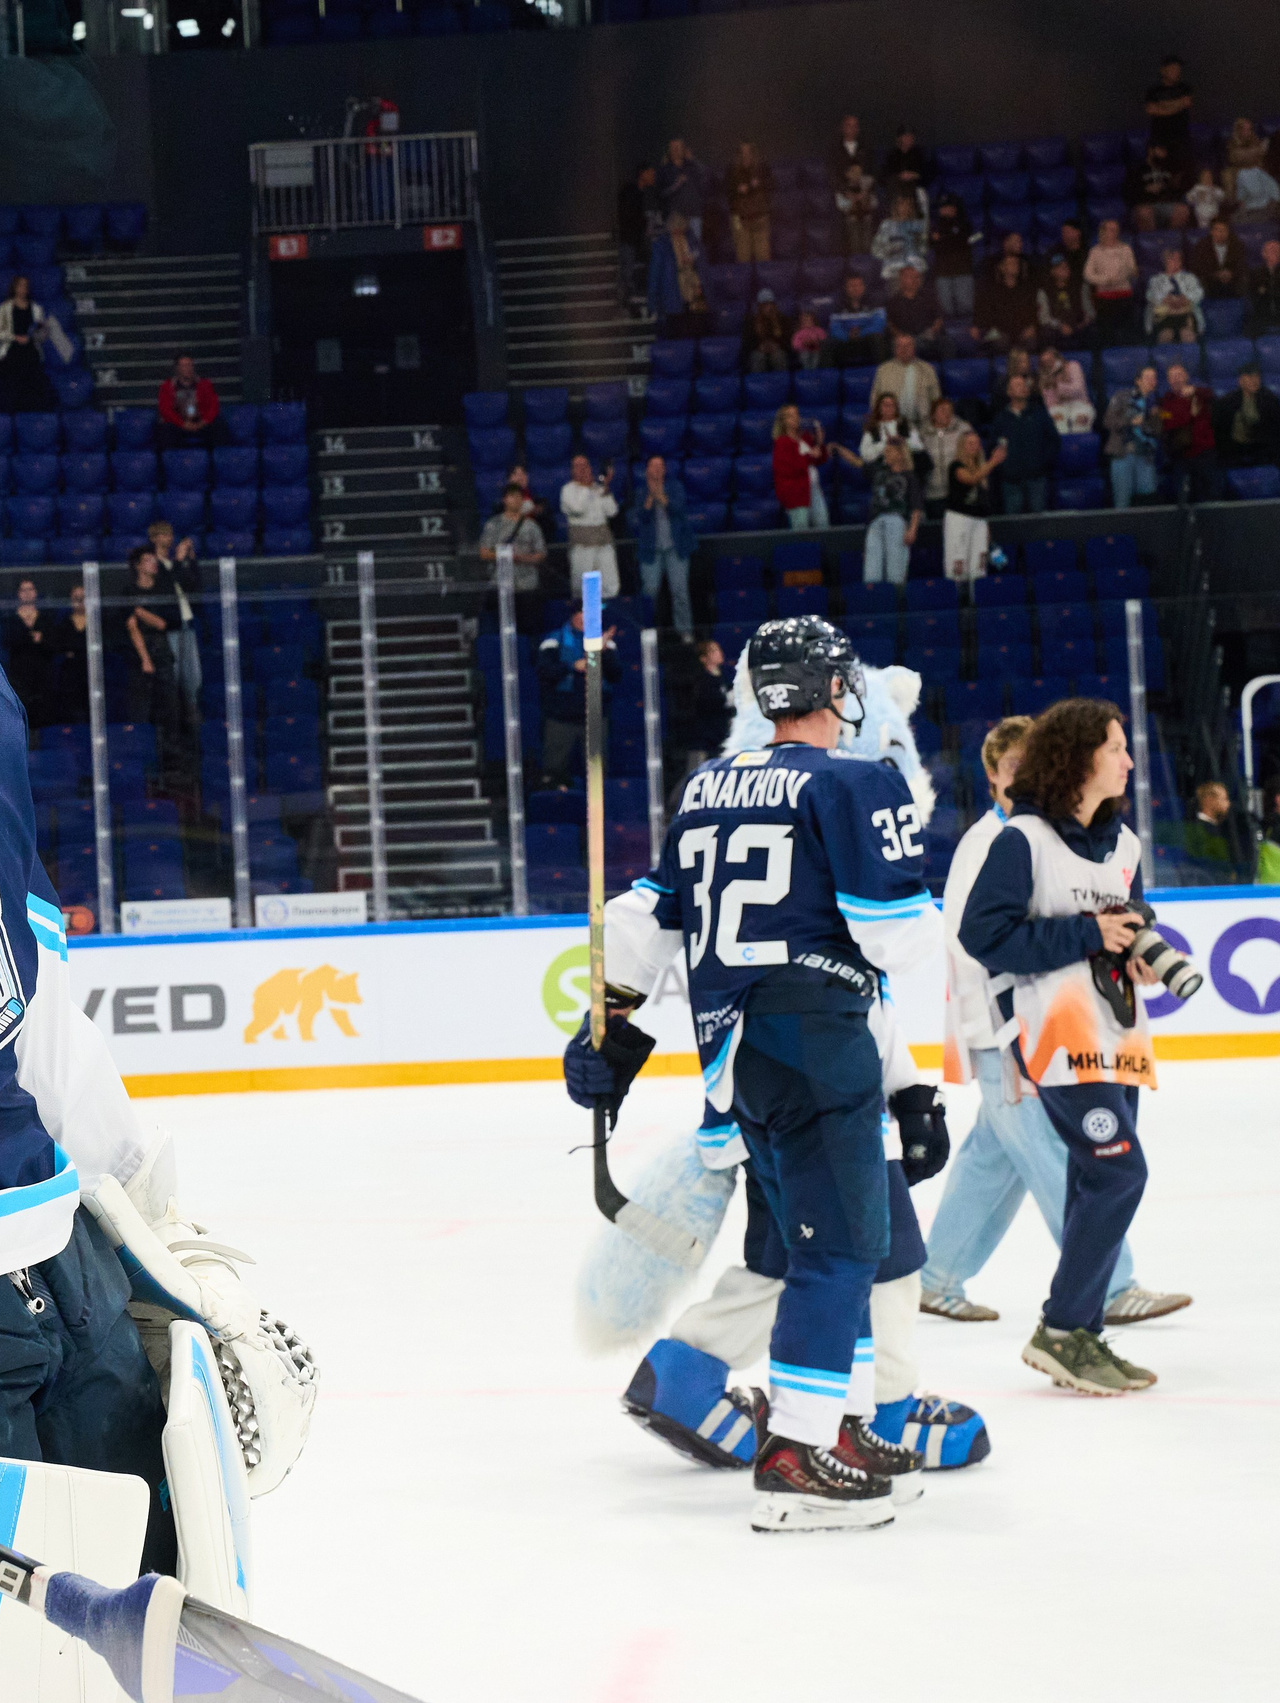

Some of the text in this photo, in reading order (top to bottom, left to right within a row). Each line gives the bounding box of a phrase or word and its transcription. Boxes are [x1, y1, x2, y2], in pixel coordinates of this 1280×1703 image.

[324, 432, 435, 452] 14 14
[323, 472, 441, 496] 13 13
[323, 517, 443, 540] 12 12
[426, 563, 446, 581] 11
[766, 685, 791, 709] 32
[871, 803, 924, 861] 32
[678, 824, 794, 970] 32
[794, 953, 866, 988] AUER
